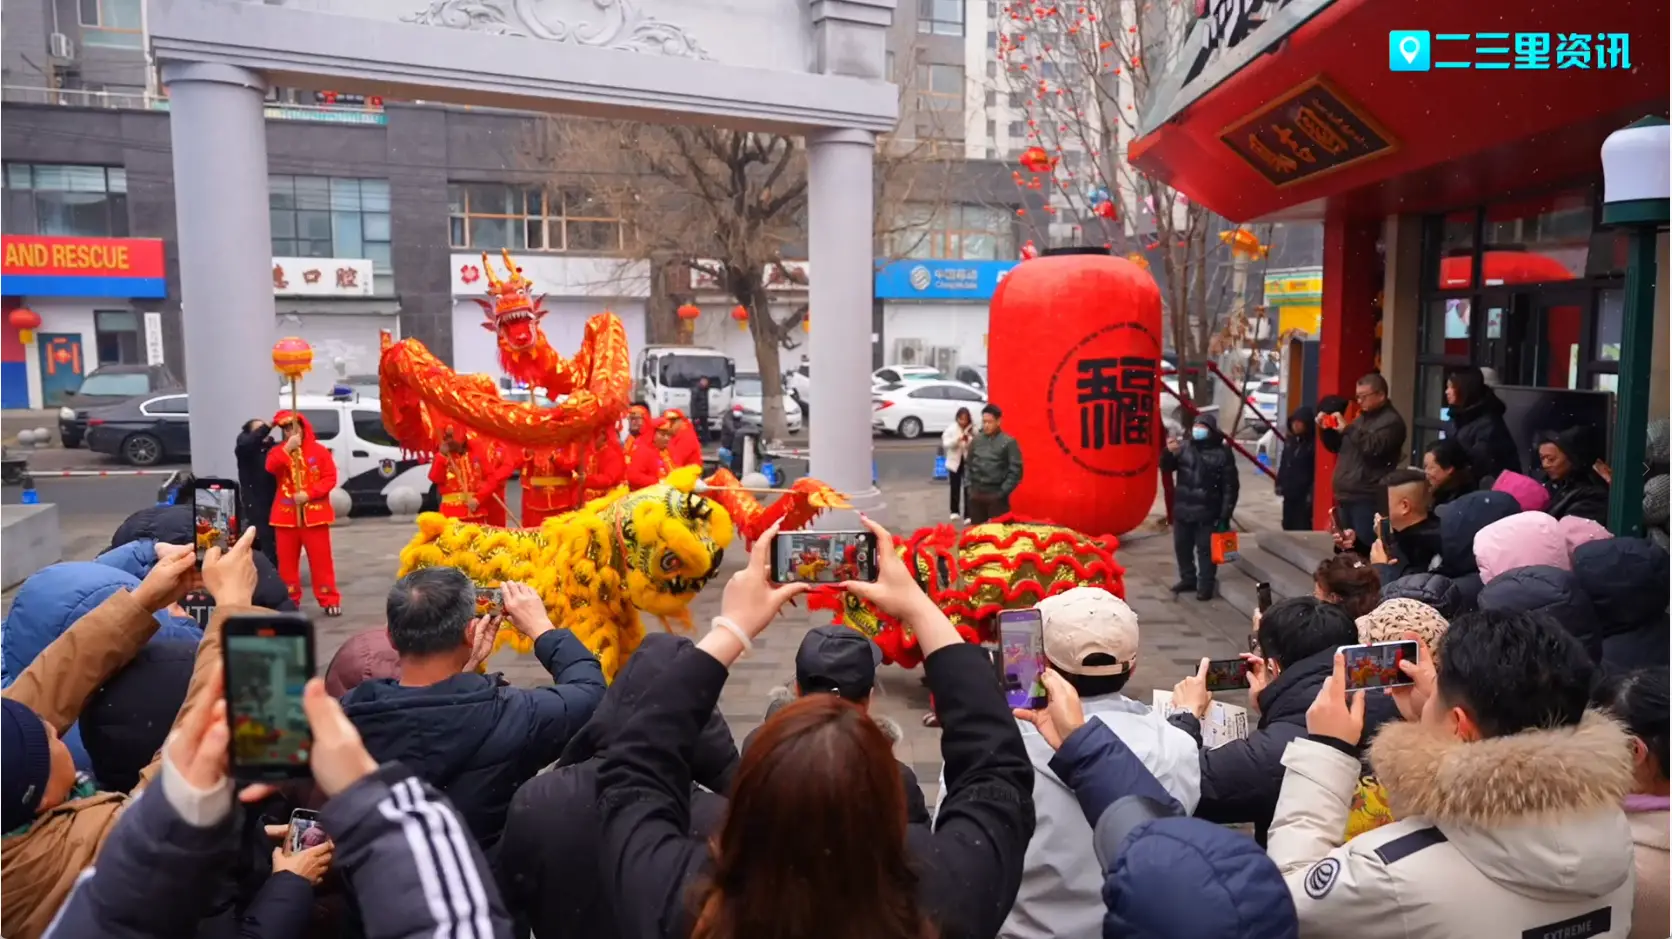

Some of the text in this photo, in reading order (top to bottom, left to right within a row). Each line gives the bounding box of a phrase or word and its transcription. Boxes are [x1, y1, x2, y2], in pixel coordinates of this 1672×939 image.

[5, 242, 130, 269] AND RESCUE
[1076, 356, 1156, 450] 福
[1543, 920, 1592, 939] EXTREME
